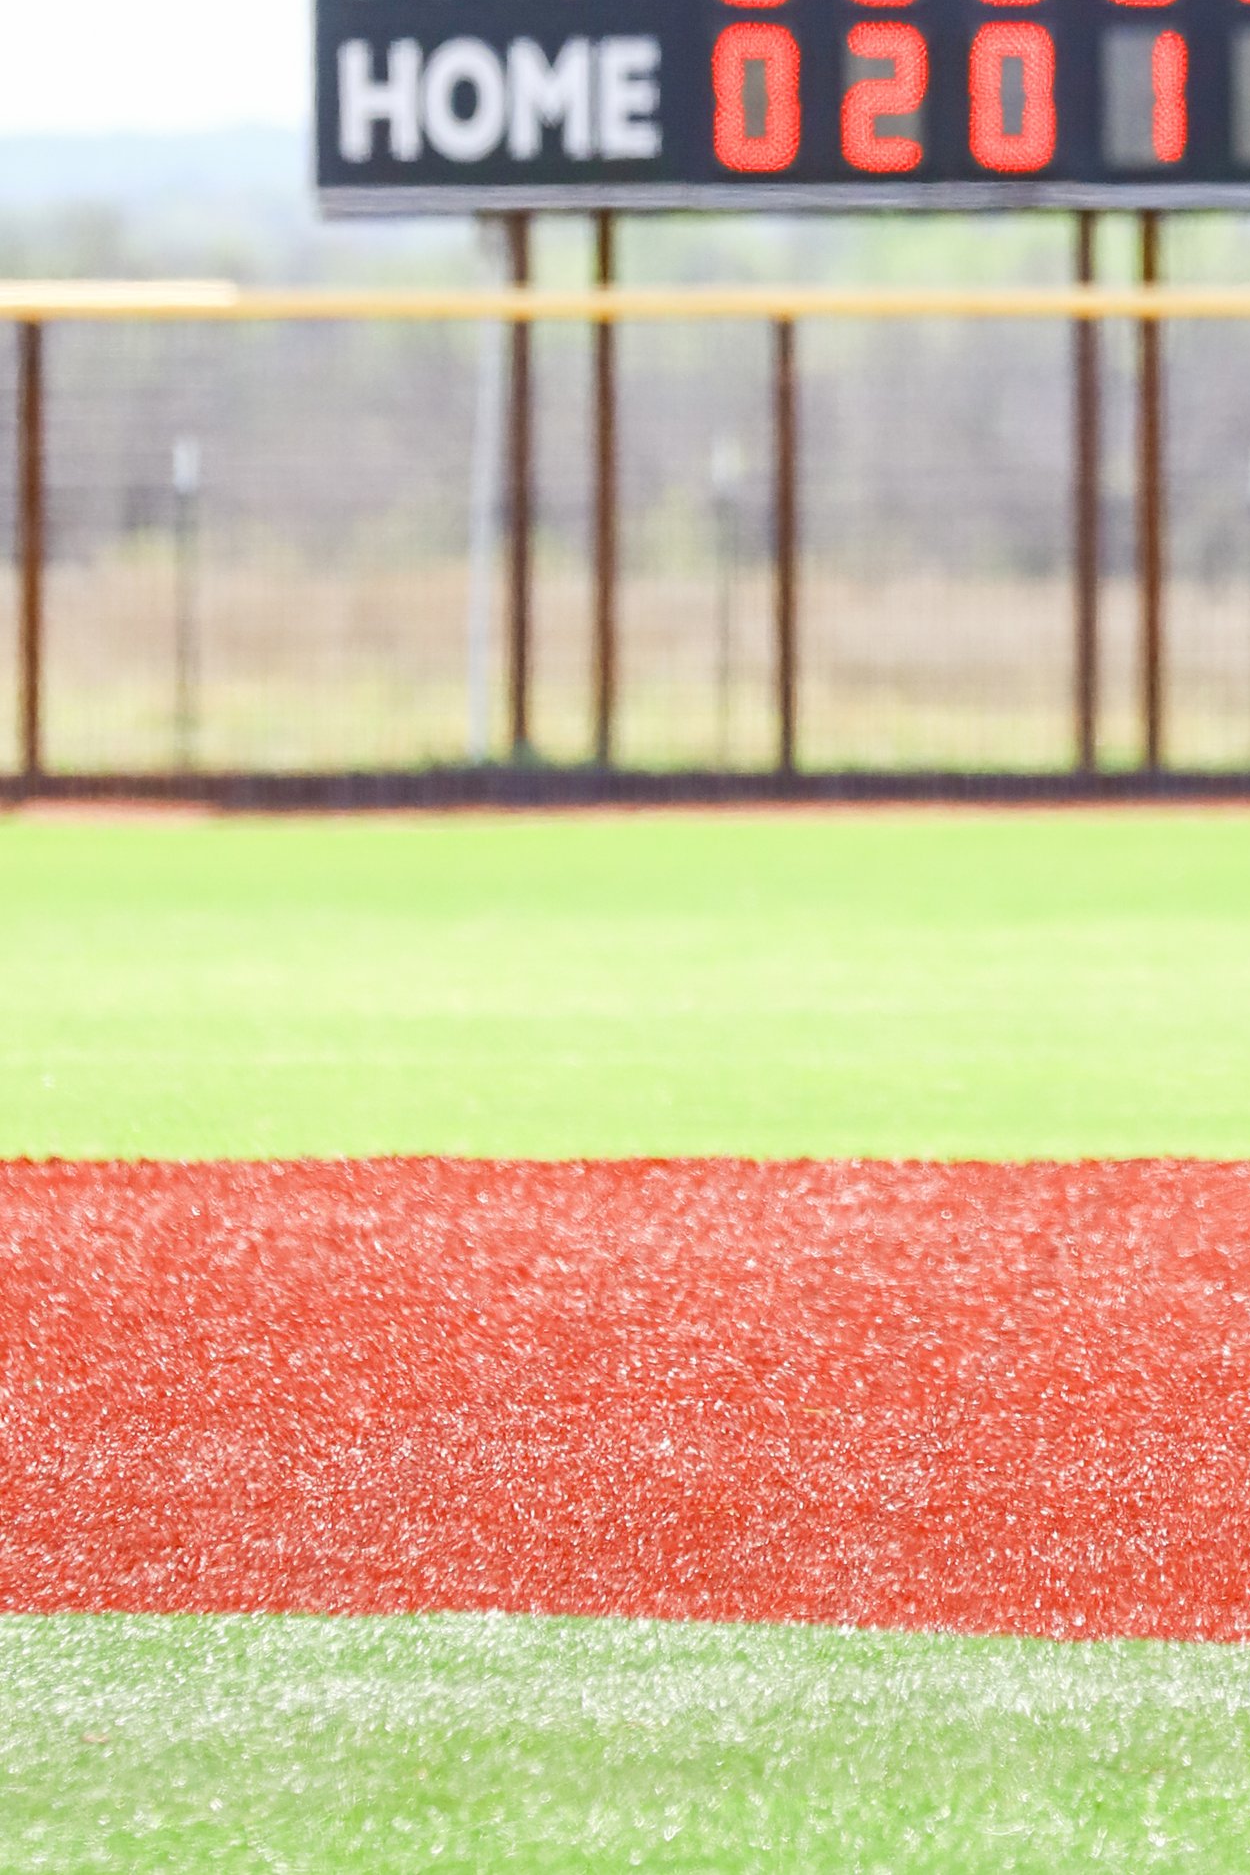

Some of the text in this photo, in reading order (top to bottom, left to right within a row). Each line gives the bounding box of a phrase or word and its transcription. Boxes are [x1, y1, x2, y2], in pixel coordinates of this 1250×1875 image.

[338, 36, 662, 161] HOME
[711, 21, 800, 172] 0
[841, 21, 929, 173] 2
[968, 21, 1057, 172] 0
[1151, 30, 1188, 163] 1
